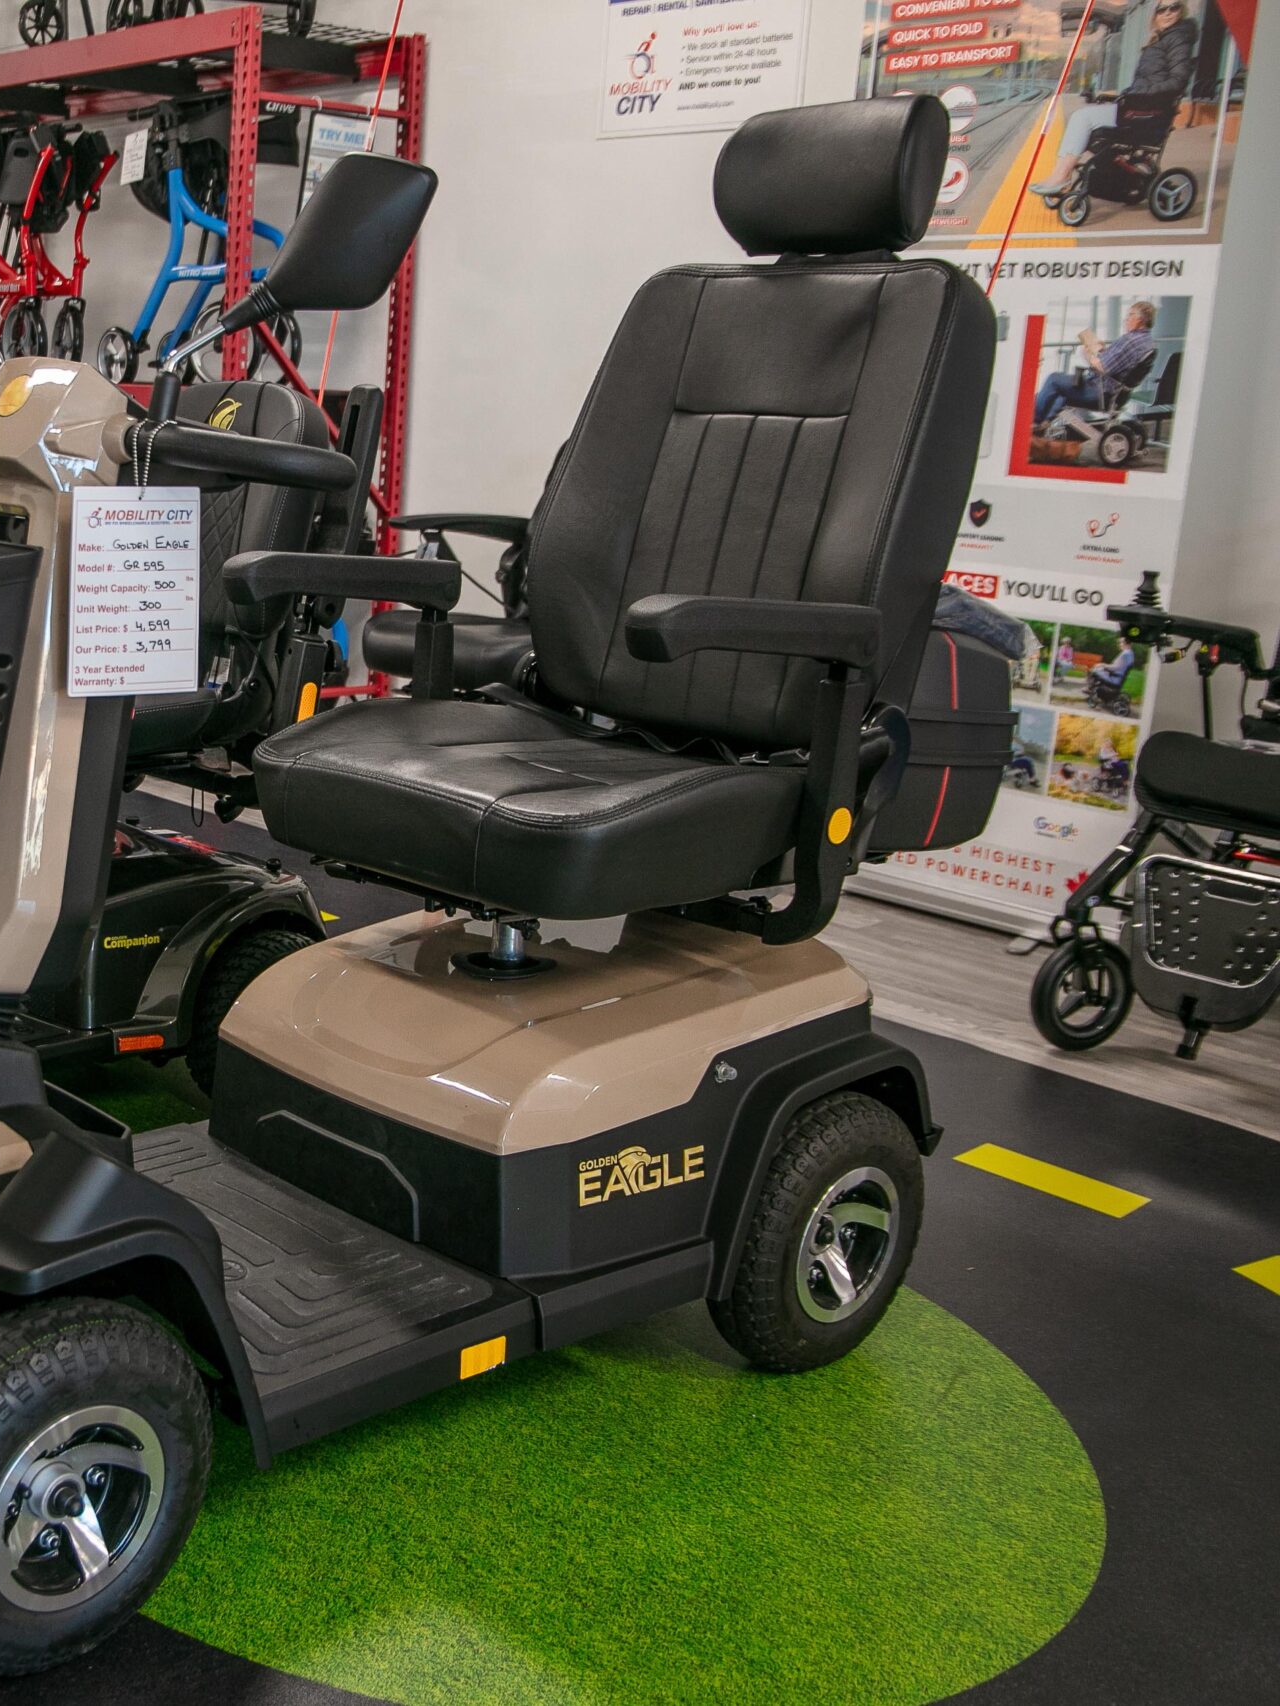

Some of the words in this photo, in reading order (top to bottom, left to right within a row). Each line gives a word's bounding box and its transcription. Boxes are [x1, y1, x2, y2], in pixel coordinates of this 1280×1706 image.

[622, 5, 652, 16] REPAIR
[657, 0, 688, 11] RENTAL
[683, 27, 700, 36] Why
[727, 22, 744, 31] love
[892, 28, 931, 44] QUICK
[933, 26, 950, 39] TO
[951, 22, 983, 36] FOLD
[700, 42, 717, 50] stock
[729, 36, 760, 46] standard
[762, 33, 793, 43] batteries
[686, 54, 711, 64] Service
[713, 52, 732, 61] within
[757, 48, 777, 56] hours
[889, 56, 920, 70] EASY
[922, 53, 939, 66] TO
[941, 45, 1014, 64] TRANSPORT
[685, 67, 721, 77] Emergency
[725, 64, 748, 72] service
[751, 60, 781, 70] available
[609, 79, 672, 96] MOBILITY
[679, 82, 696, 91] AND
[711, 79, 732, 87] come
[616, 93, 662, 116] CITY
[319, 128, 342, 141] TRY
[985, 262, 1018, 279] YET
[1023, 261, 1103, 279] ROBUST
[1106, 259, 1185, 278] DESIGN
[104, 510, 164, 520] MOBILITY
[166, 509, 193, 520] CITY
[78, 544, 105, 552] Make:
[77, 564, 105, 572] Model
[123, 560, 140, 571] GR
[144, 561, 165, 571] 595
[77, 584, 108, 594] Weight
[110, 584, 150, 594] Capacity:
[154, 581, 176, 591] 500
[946, 572, 995, 594] ACES
[1005, 580, 1068, 603] YOU'LL
[1074, 588, 1104, 607] GO
[76, 605, 95, 613] Unit
[97, 604, 130, 615] Weight:
[139, 601, 162, 611] 300
[76, 625, 94, 634] List
[95, 625, 120, 633] Price:
[123, 624, 128, 633] $
[135, 619, 170, 632] 4,599
[75, 646, 92, 654] Our
[94, 645, 120, 653] Price:
[122, 644, 128, 653] $
[136, 639, 171, 653] 3,799
[74, 666, 80, 674] 3
[82, 666, 102, 674] Year
[105, 664, 145, 674] Extended
[74, 678, 117, 687] Warranty:
[120, 676, 125, 686] $
[1033, 816, 1079, 837] Google
[970, 845, 1056, 875] HIGHEST
[924, 857, 1056, 898] POWERCHAIR
[104, 935, 160, 949] Companion
[579, 1154, 618, 1171] GOLDEN
[579, 1145, 705, 1207] EAGLE
